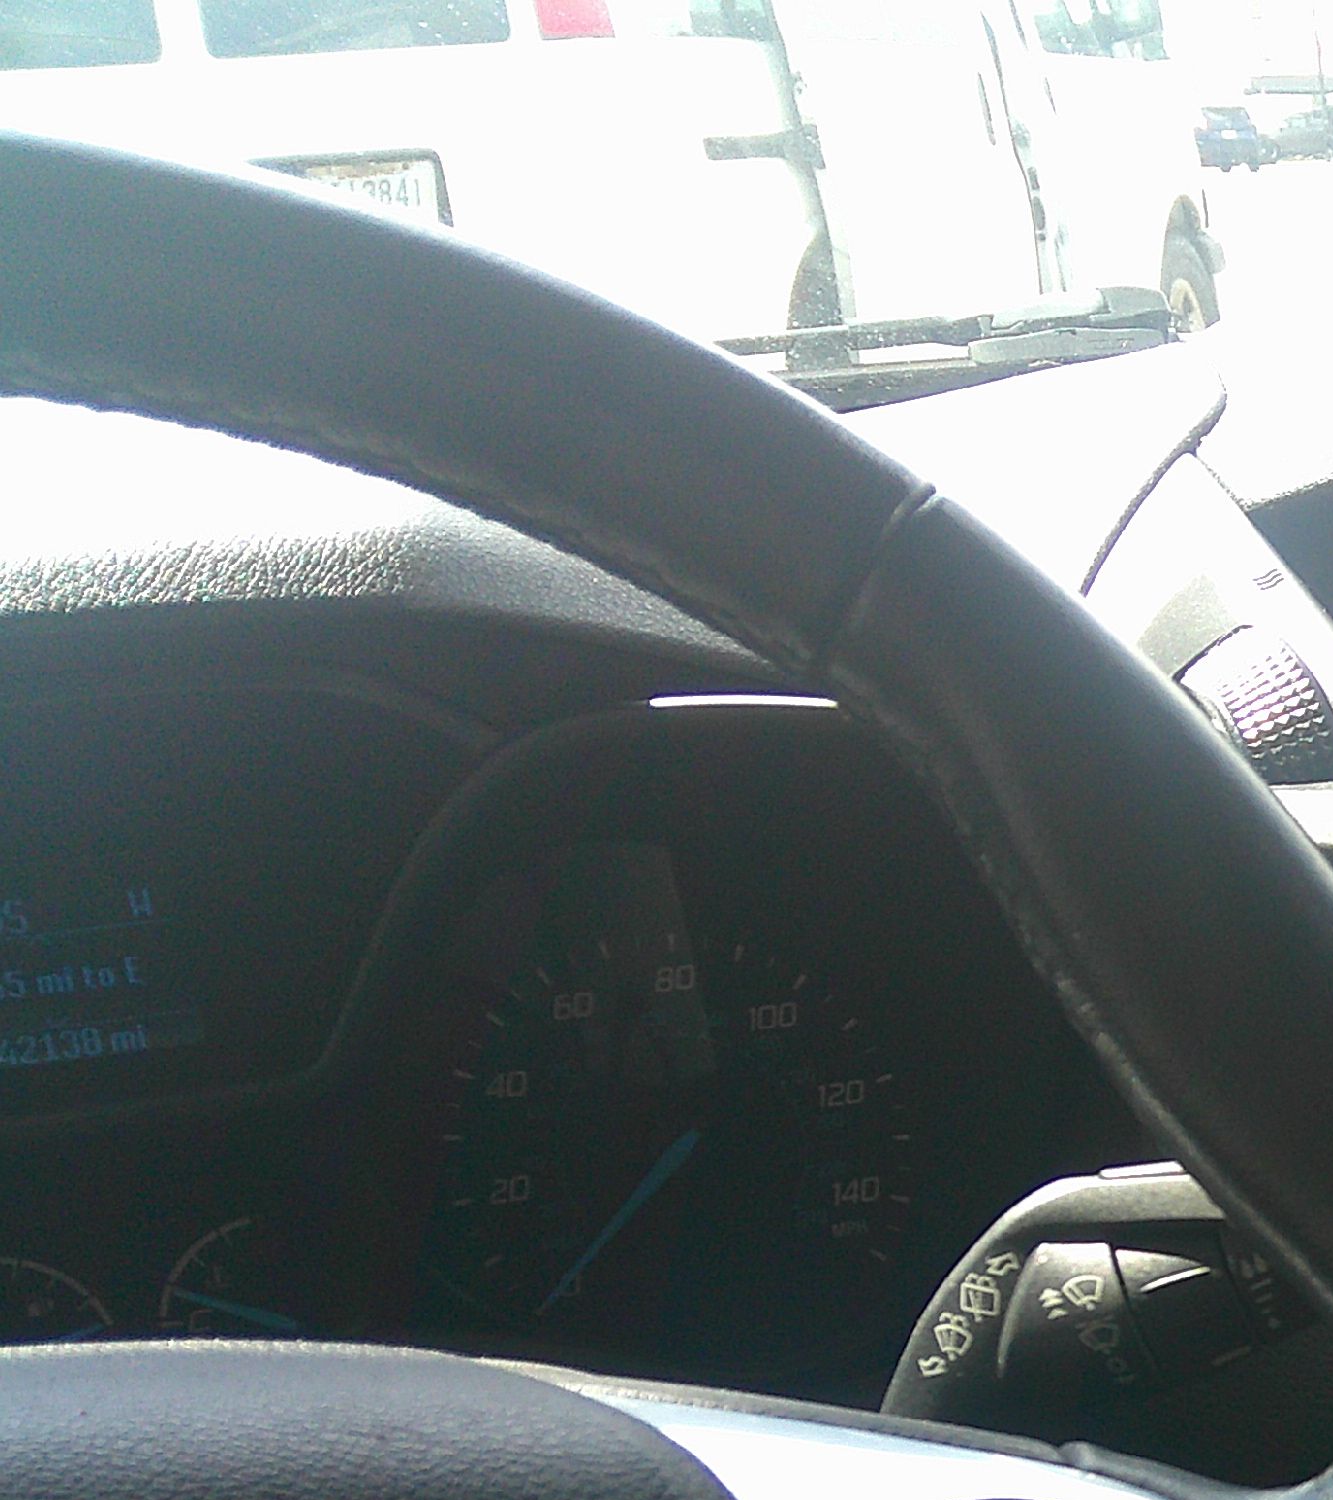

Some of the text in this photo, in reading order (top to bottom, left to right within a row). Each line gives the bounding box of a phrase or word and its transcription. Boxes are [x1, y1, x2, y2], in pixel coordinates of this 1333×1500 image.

[655, 964, 696, 994] 80
[553, 992, 594, 1022] 60
[749, 1002, 798, 1032] 100
[486, 1071, 527, 1099] 40
[818, 1080, 865, 1107] 120
[491, 1174, 531, 1204] 20
[832, 1176, 880, 1207] 140
